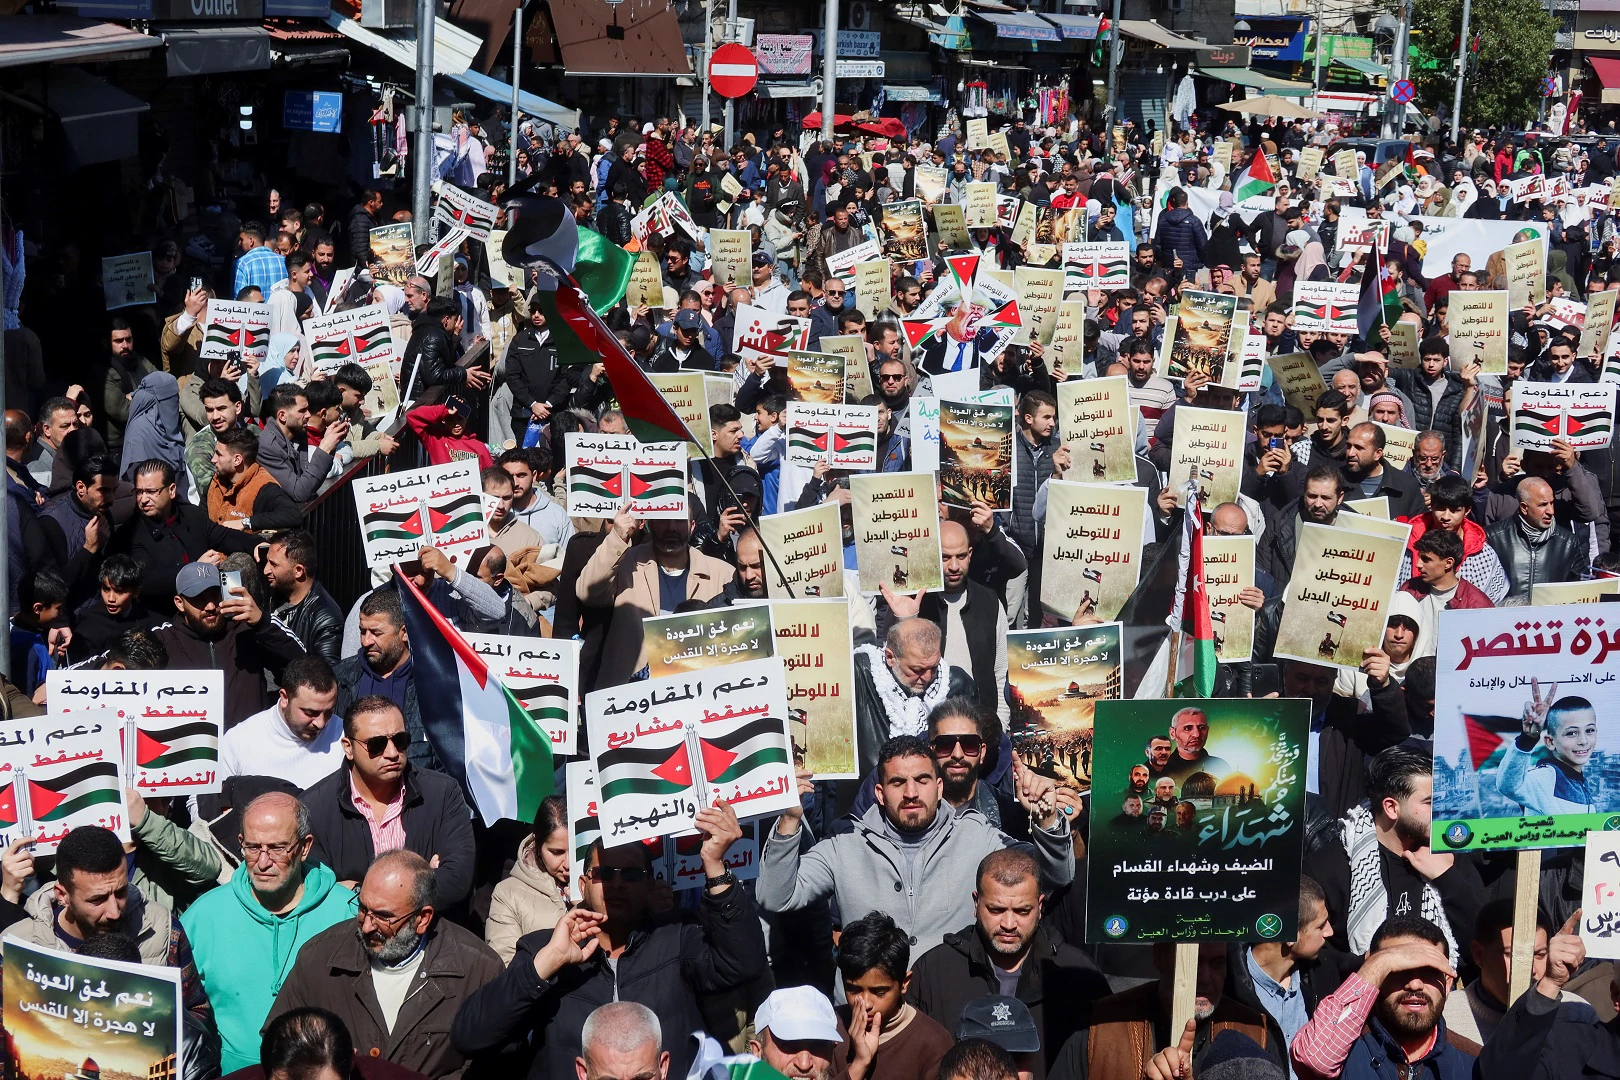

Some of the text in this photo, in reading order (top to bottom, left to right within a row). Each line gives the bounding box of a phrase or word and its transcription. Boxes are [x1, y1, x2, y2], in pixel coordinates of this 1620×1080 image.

[854, 42, 868, 50] bazar
[1074, 392, 1109, 406] لا للتهجير
[1522, 387, 1574, 398] المقاومة
[795, 406, 840, 416] المقاومة
[950, 406, 971, 415] العودة
[1522, 402, 1560, 410] مشاريع
[1074, 409, 1112, 423] لا للتوطين
[794, 420, 869, 430] يسقط مشاريع
[1067, 426, 1122, 441] لا للوطن البديل
[576, 441, 636, 452] المقاومة
[577, 456, 676, 468] يسقط مشاريع
[834, 455, 872, 465] التصفية
[366, 470, 469, 493] دعم المقاومة
[369, 487, 471, 513] يسقط مشاريع
[872, 488, 914, 502] لا للتهجير
[631, 501, 683, 514] التصفية
[1070, 504, 1120, 516] لا للتهجير
[872, 508, 917, 522] لا للتوطين
[435, 529, 484, 549] التصفية
[864, 528, 929, 543] لا للوطن البديل
[1067, 526, 1120, 540] لا للتوطين
[1053, 547, 1130, 565] لا للوطن البديل
[1322, 548, 1375, 562] لا للتهجير
[1315, 569, 1372, 586] لا للتوطين
[1298, 588, 1379, 611] لا للوطن البديل
[667, 618, 754, 642] نعم لحق العودة
[1026, 635, 1106, 652] نعم لحق العودة
[1455, 620, 1563, 670] تنتصر
[519, 651, 560, 661] دعم
[663, 639, 758, 664] لا هجرة إلا للقدس
[1022, 652, 1108, 669] لا هجرة إلا للقدس
[505, 667, 559, 684] يسقط
[1595, 672, 1615, 684] على
[61, 680, 208, 700] دعم المقاومة
[831, 683, 839, 696] لا
[1470, 677, 1505, 690] والإبادة
[603, 676, 768, 715] دعم المقاومة
[141, 706, 207, 720] يسقط
[606, 704, 769, 749] يسقط مشاريع
[46, 724, 102, 745] دعم
[30, 749, 103, 767] يسقط
[137, 770, 215, 792] التصفية
[611, 798, 695, 836] والتهجير
[1113, 858, 1272, 877] الضيف وشهداء القسام
[1127, 887, 1256, 903] على درب قادة مؤتة
[1177, 914, 1210, 923] شعبة
[1138, 928, 1168, 938] العين
[1200, 927, 1248, 937] الوحدات
[27, 963, 153, 1007] نعم لحق العودة
[19, 1000, 155, 1037] لا هجرة إلا للقدس
